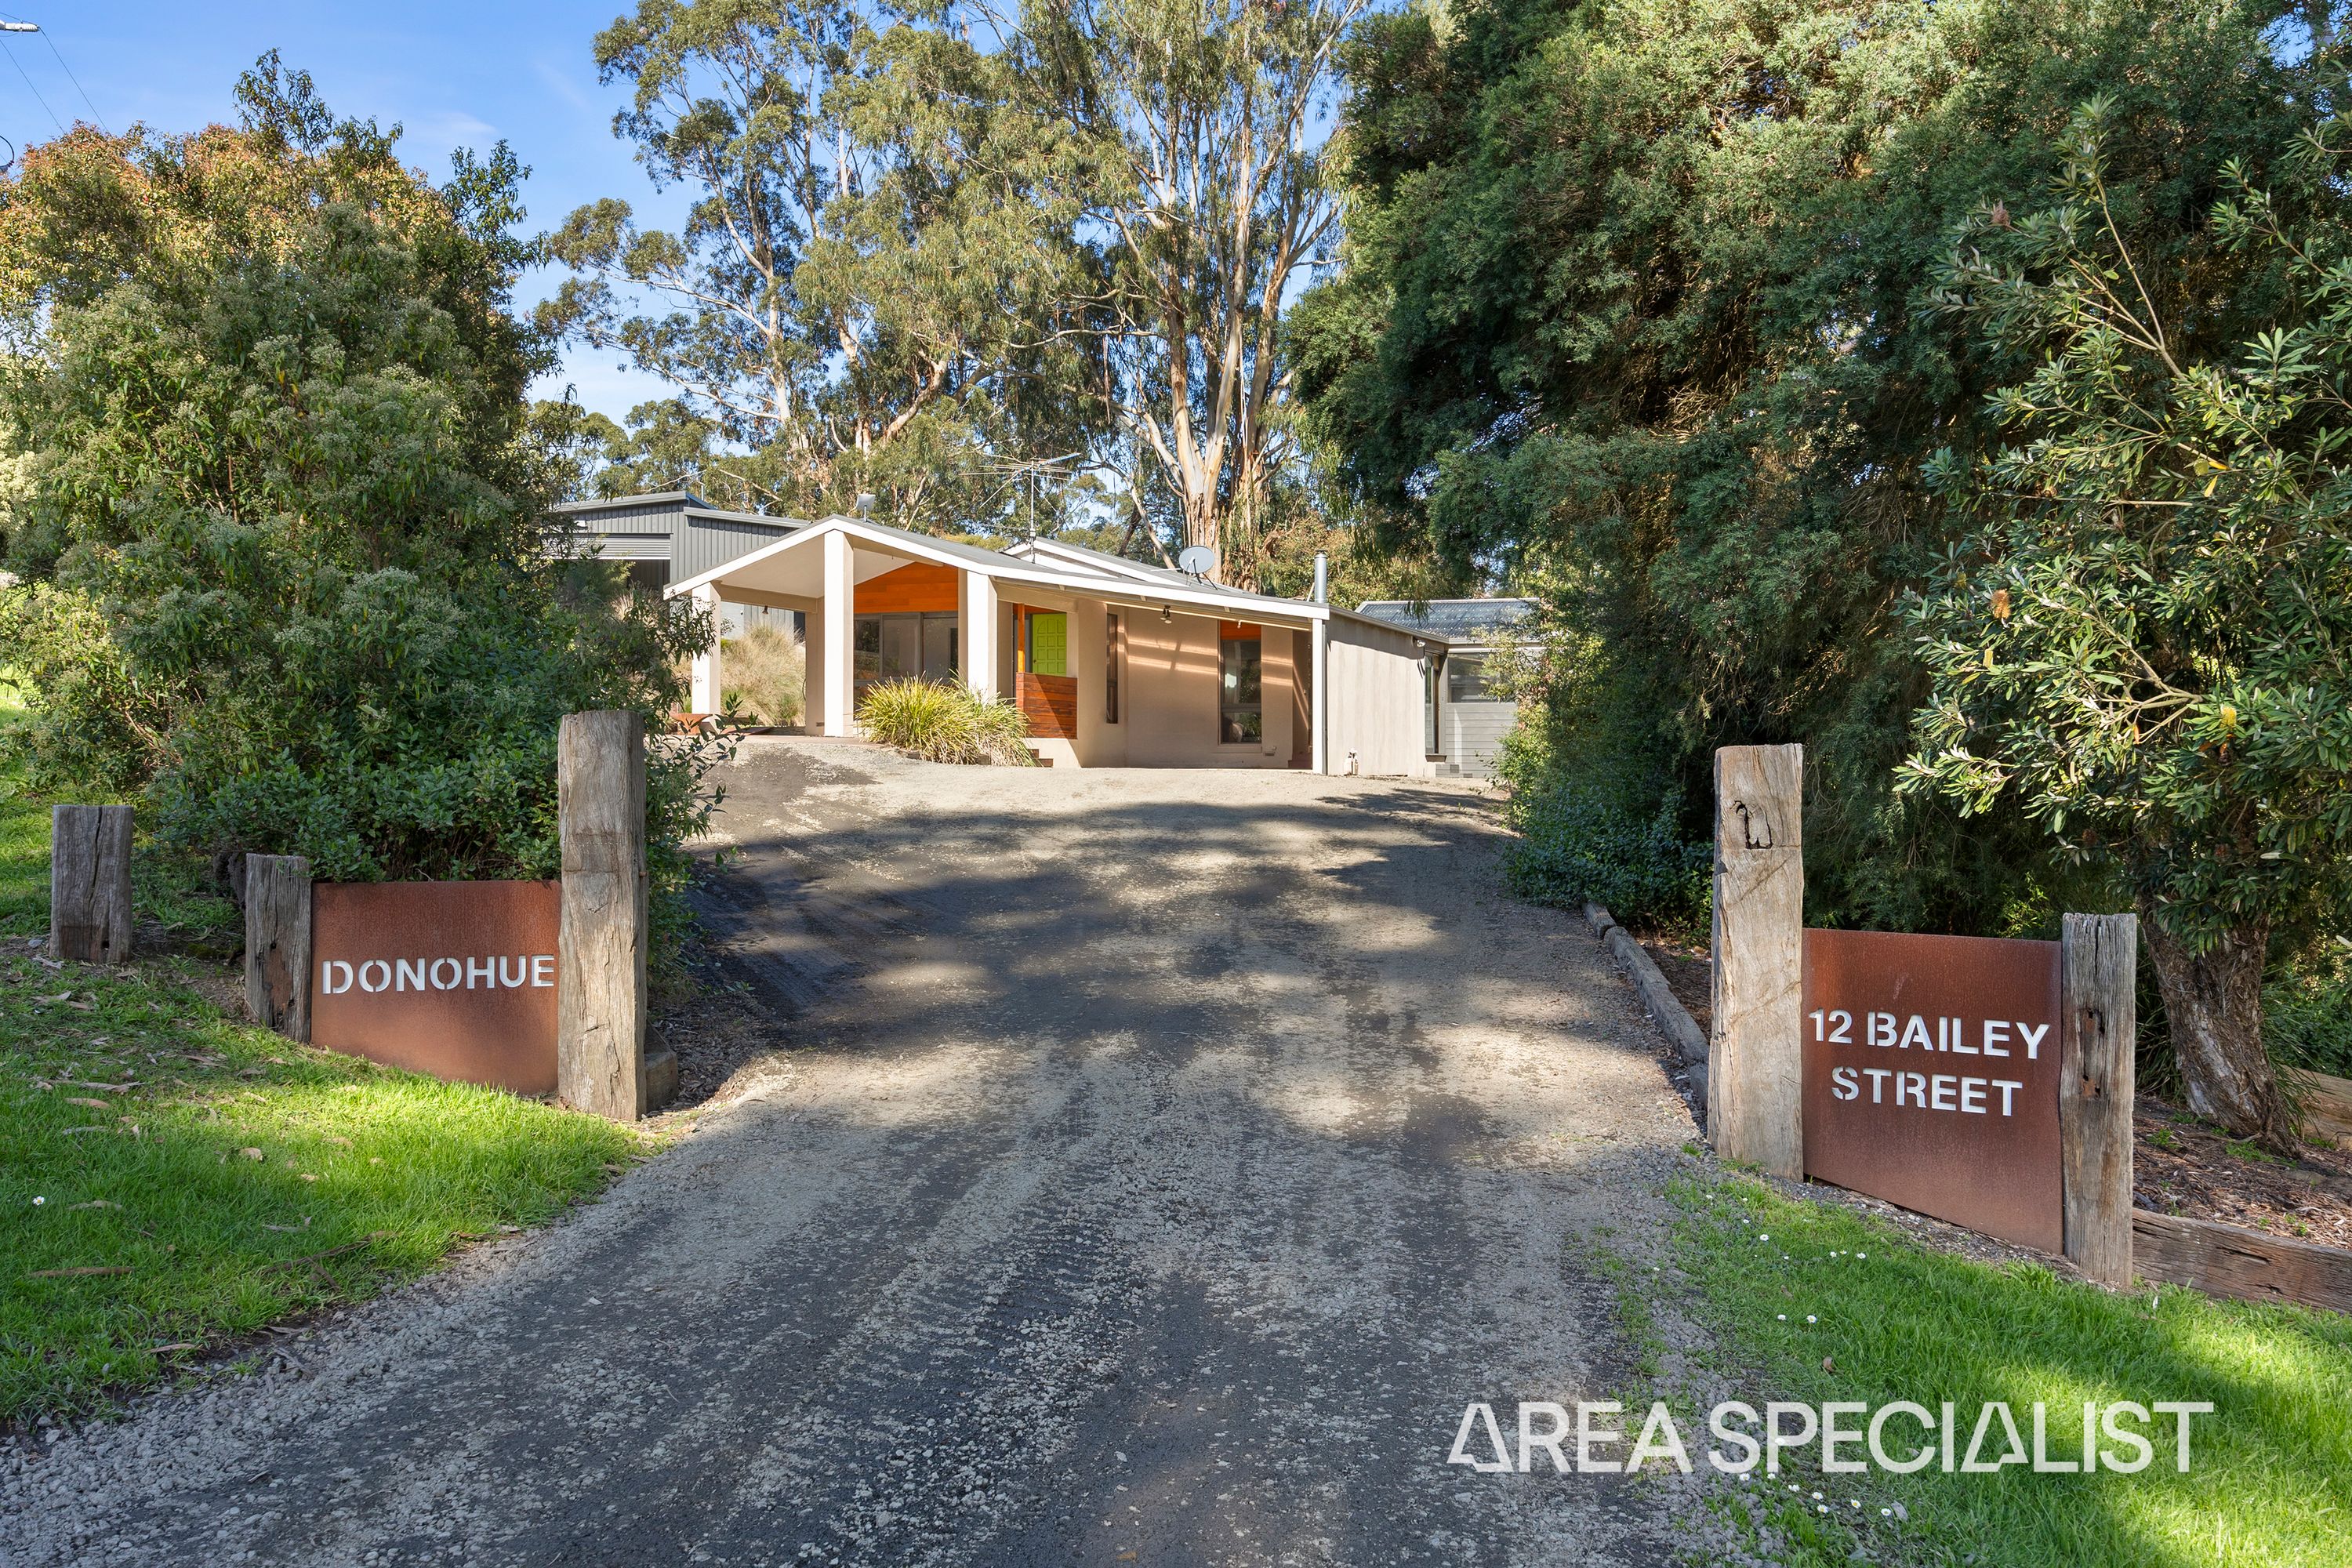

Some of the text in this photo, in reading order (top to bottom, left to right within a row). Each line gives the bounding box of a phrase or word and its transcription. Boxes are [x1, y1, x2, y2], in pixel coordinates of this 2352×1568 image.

[321, 954, 555, 994] DONOHUE
[1809, 1008, 2051, 1059] 12 BAILEY
[1831, 1066, 2023, 1116] STREET
